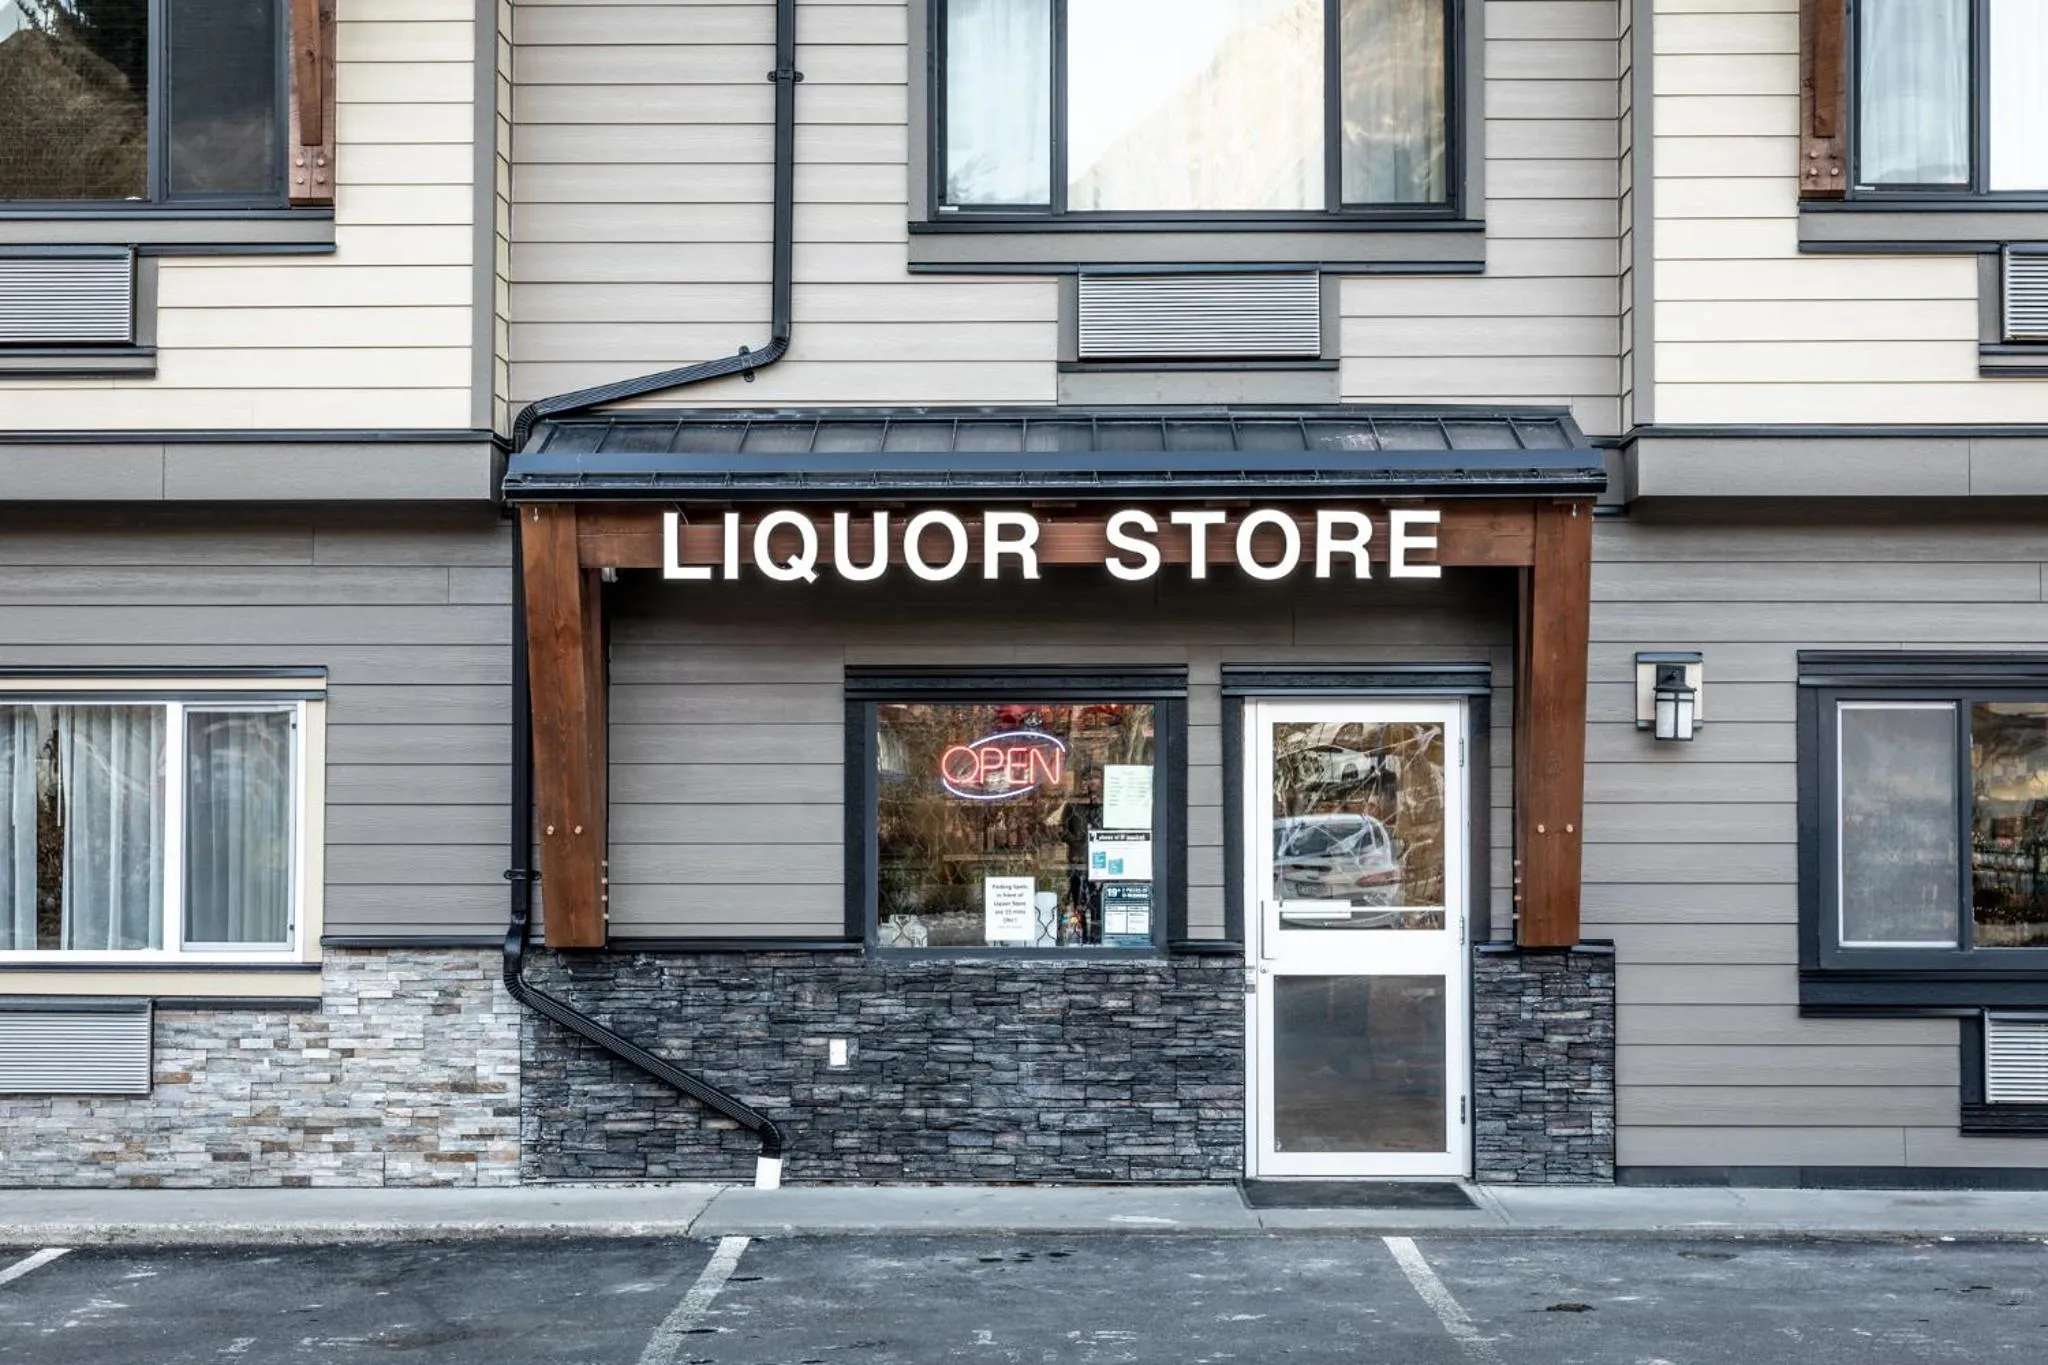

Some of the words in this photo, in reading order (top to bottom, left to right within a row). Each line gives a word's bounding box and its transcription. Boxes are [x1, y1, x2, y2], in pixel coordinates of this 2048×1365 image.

[663, 510, 1040, 583] LIQUOR
[1105, 509, 1441, 581] STORE
[941, 746, 1061, 785] OPEN
